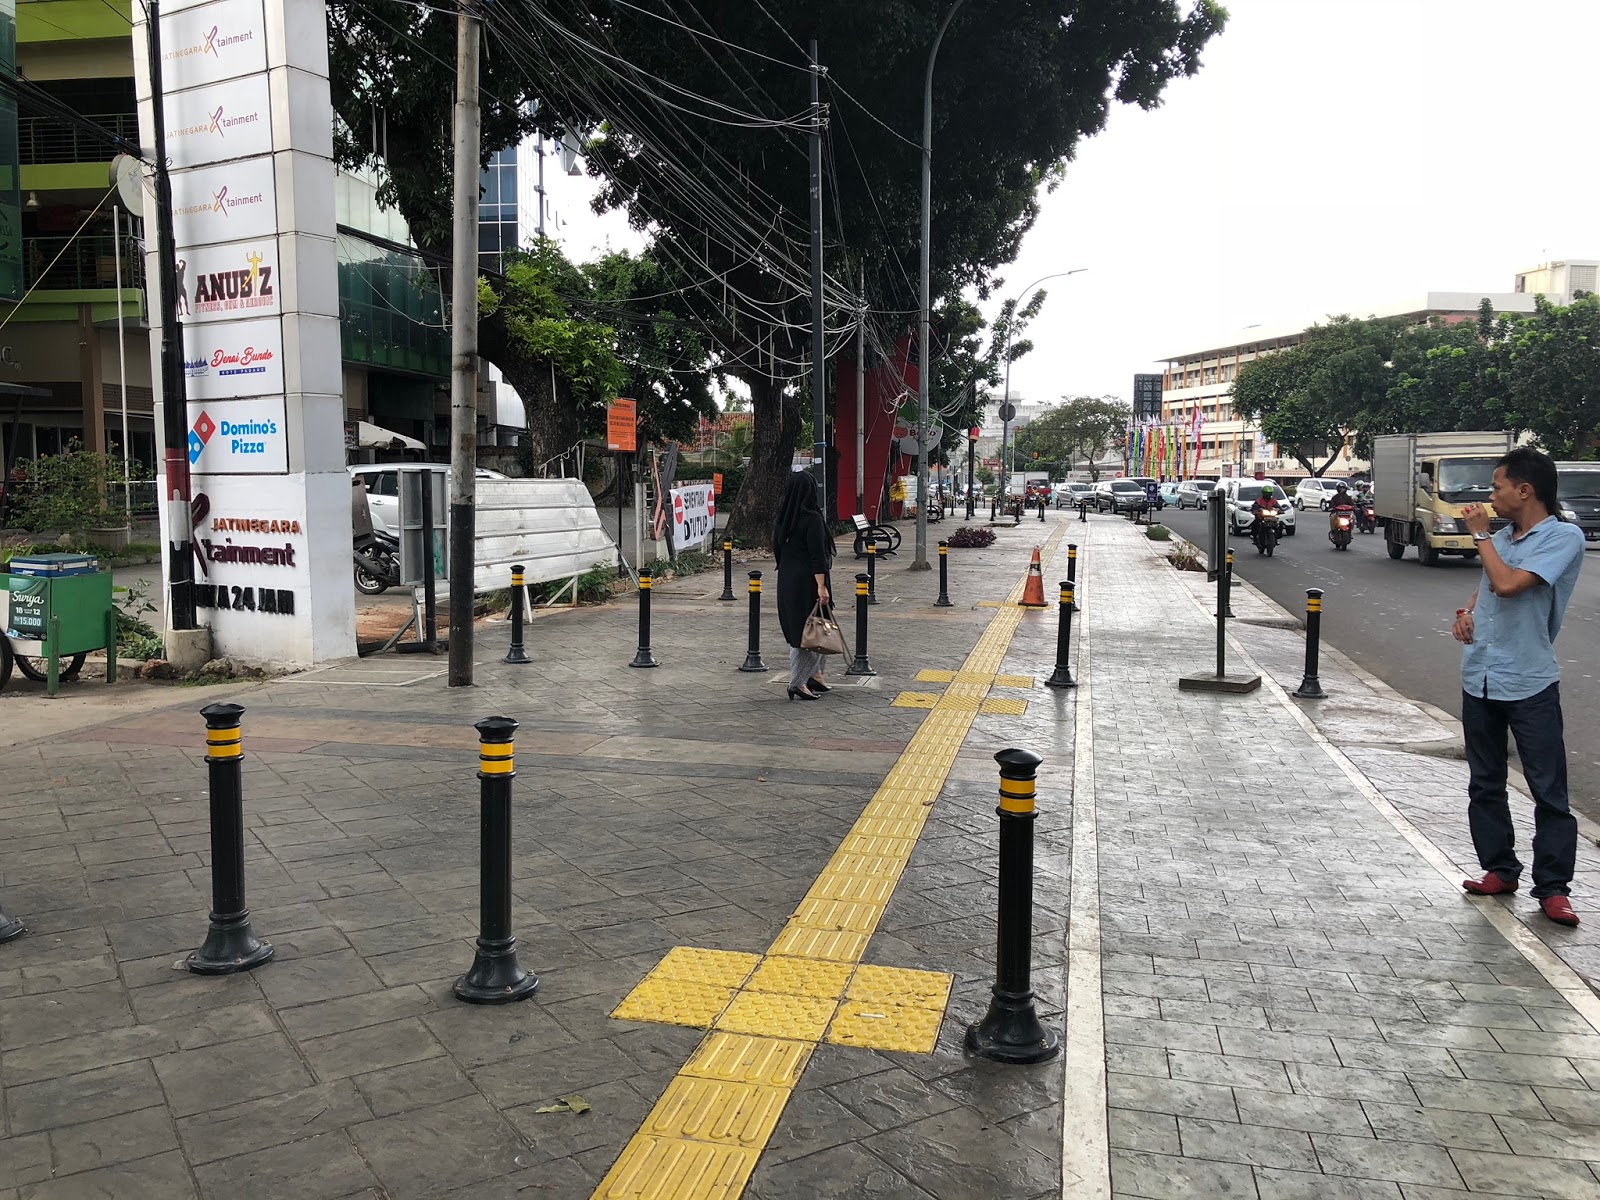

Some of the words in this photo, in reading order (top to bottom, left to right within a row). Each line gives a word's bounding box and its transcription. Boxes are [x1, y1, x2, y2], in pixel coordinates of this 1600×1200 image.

[166, 124, 208, 139] JATINEGARA
[173, 203, 212, 216] ATINEGARA
[220, 418, 277, 436] Domino's
[231, 438, 265, 454] Pizza
[211, 518, 302, 535] JATINEGARA
[12, 590, 44, 607] Surya
[231, 585, 256, 612] 24
